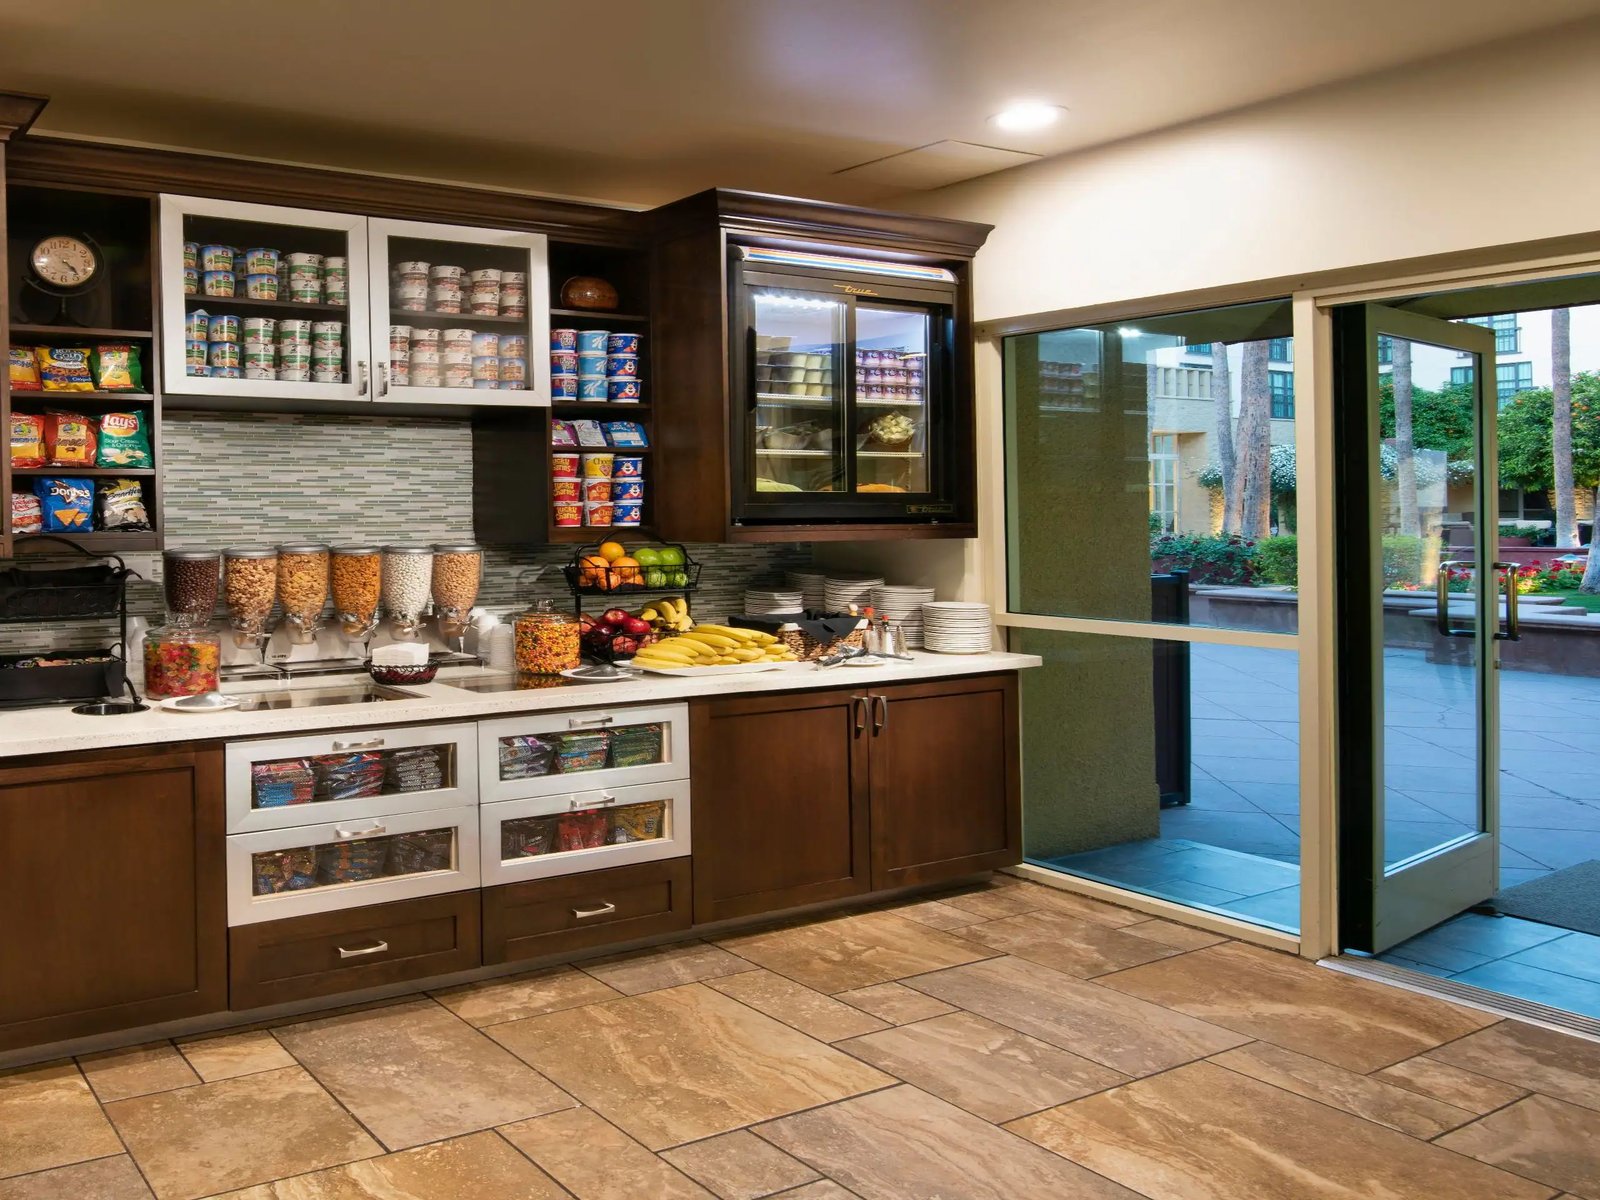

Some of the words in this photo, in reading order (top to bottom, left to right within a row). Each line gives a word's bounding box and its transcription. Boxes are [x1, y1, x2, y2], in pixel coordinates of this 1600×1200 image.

[50, 241, 57, 250] 11
[58, 240, 70, 249] 12
[40, 247, 50, 255] 10
[79, 249, 87, 258] 2
[50, 272, 57, 280] 7
[60, 275, 67, 283] 6
